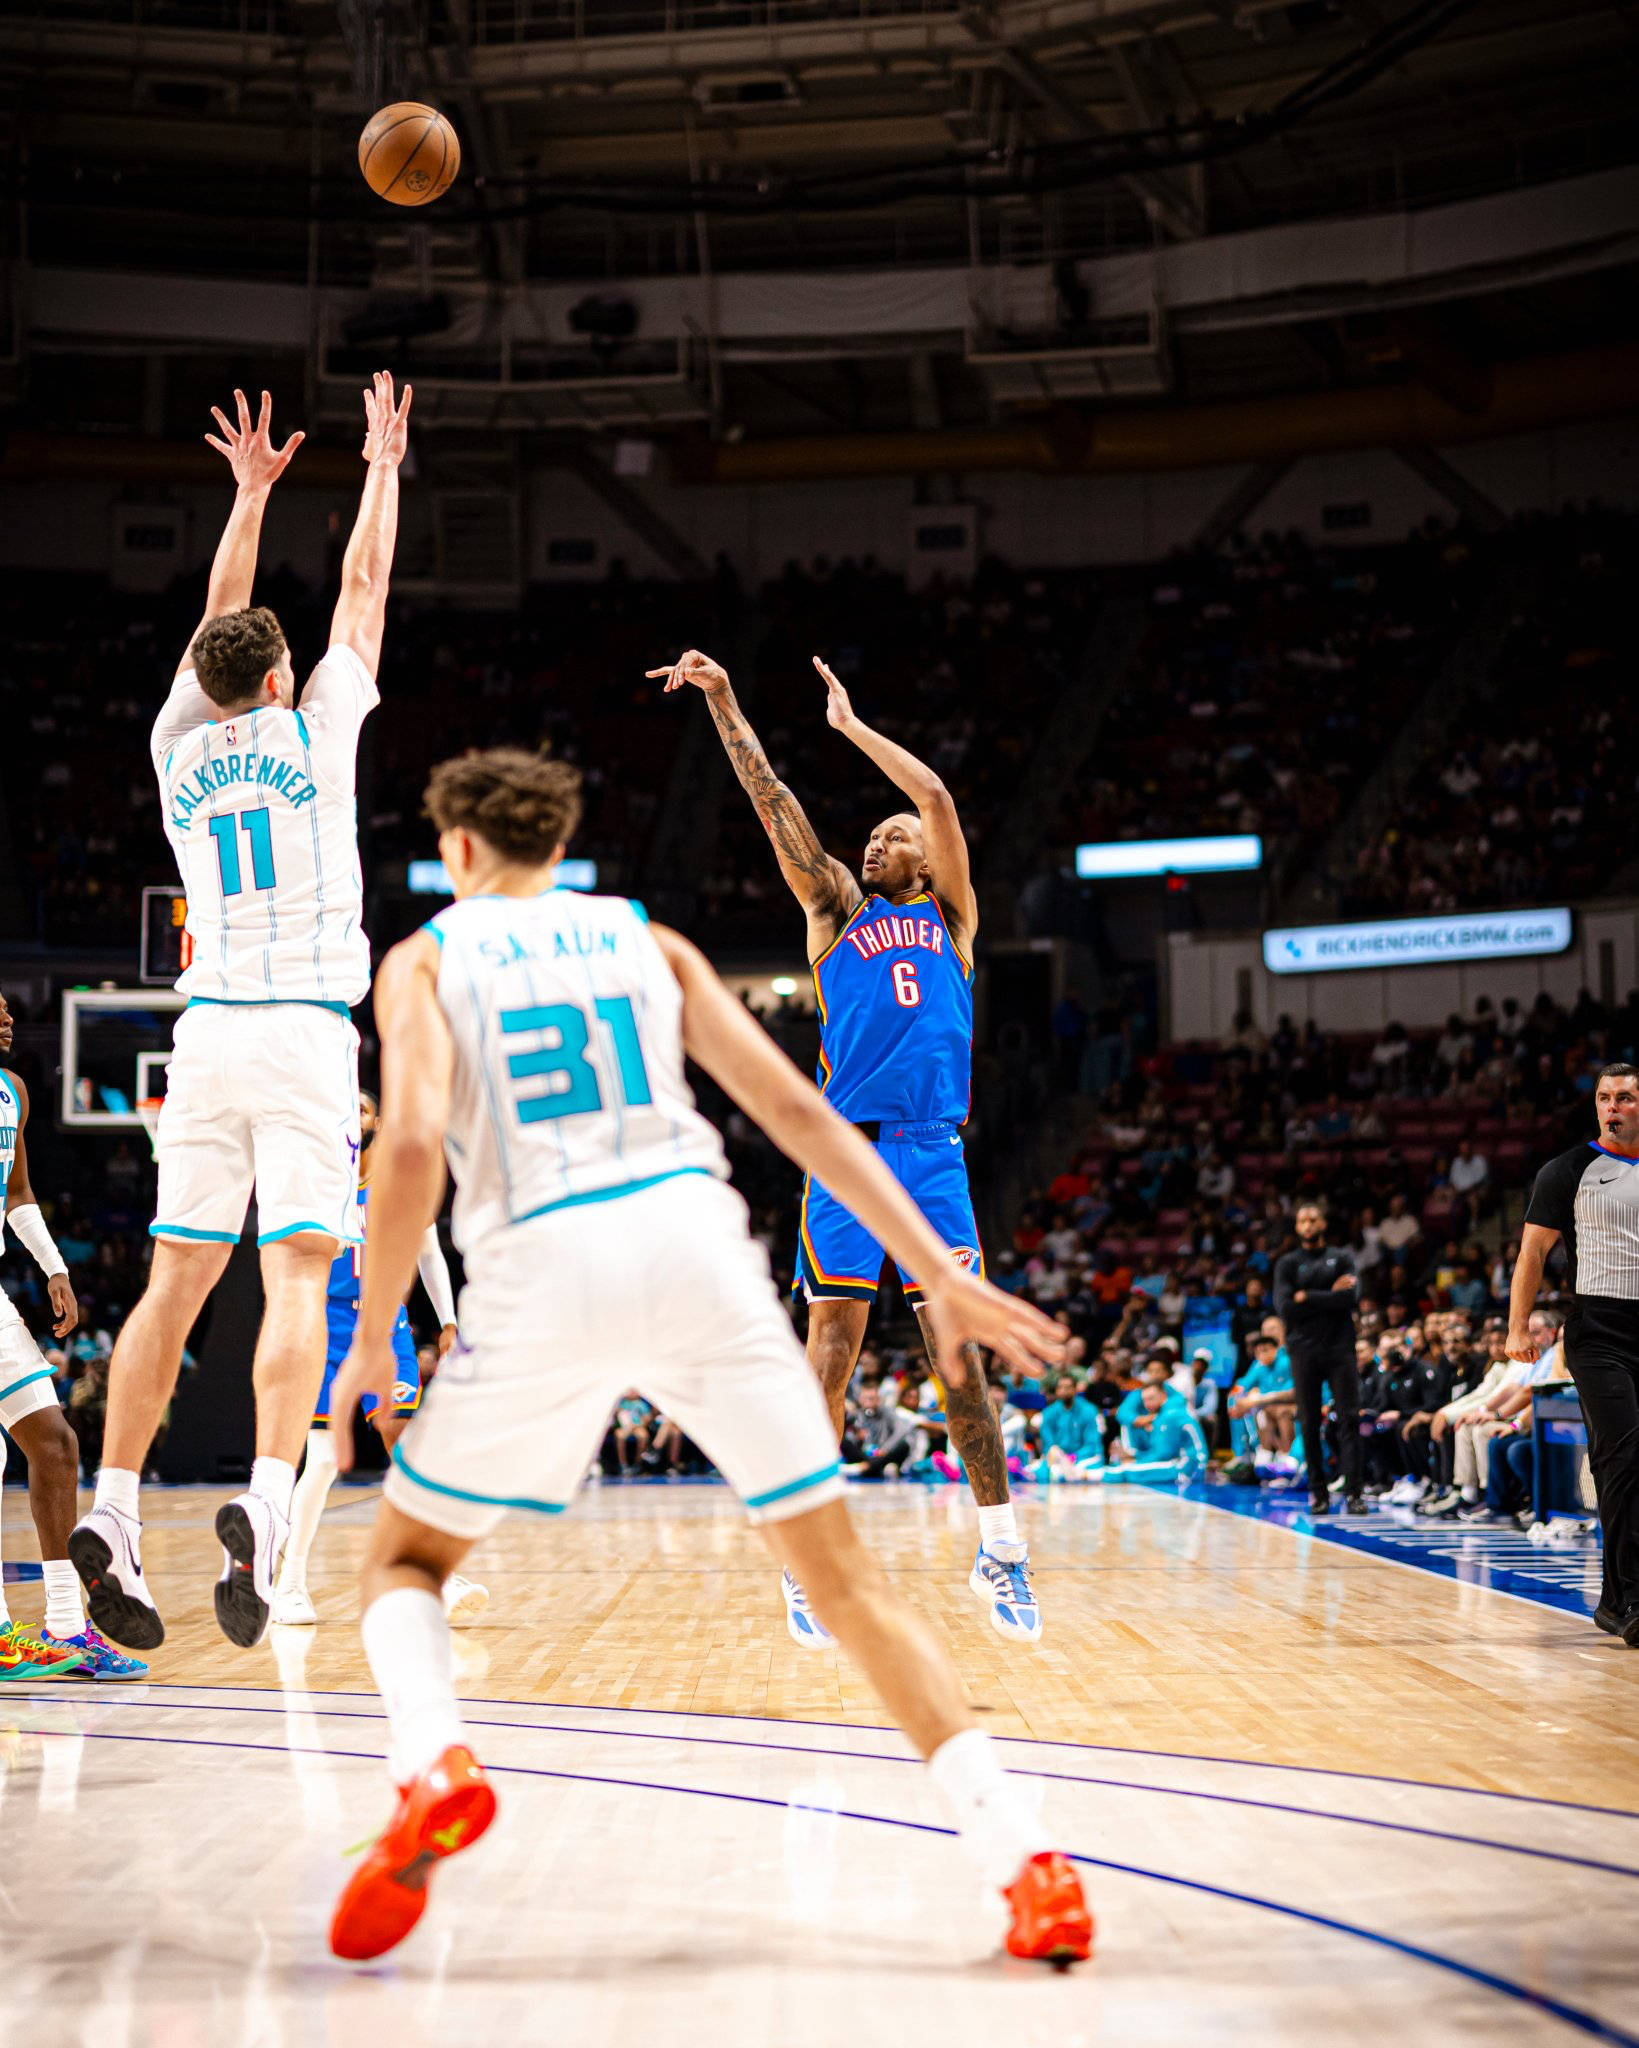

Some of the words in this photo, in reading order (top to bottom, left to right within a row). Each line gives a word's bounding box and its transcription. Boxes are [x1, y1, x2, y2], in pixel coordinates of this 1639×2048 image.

[172, 753, 318, 831] KALKBRENNER
[208, 806, 277, 897] 11
[846, 914, 944, 961] THUNDER
[890, 960, 922, 1008] 6
[500, 995, 653, 1125] 31
